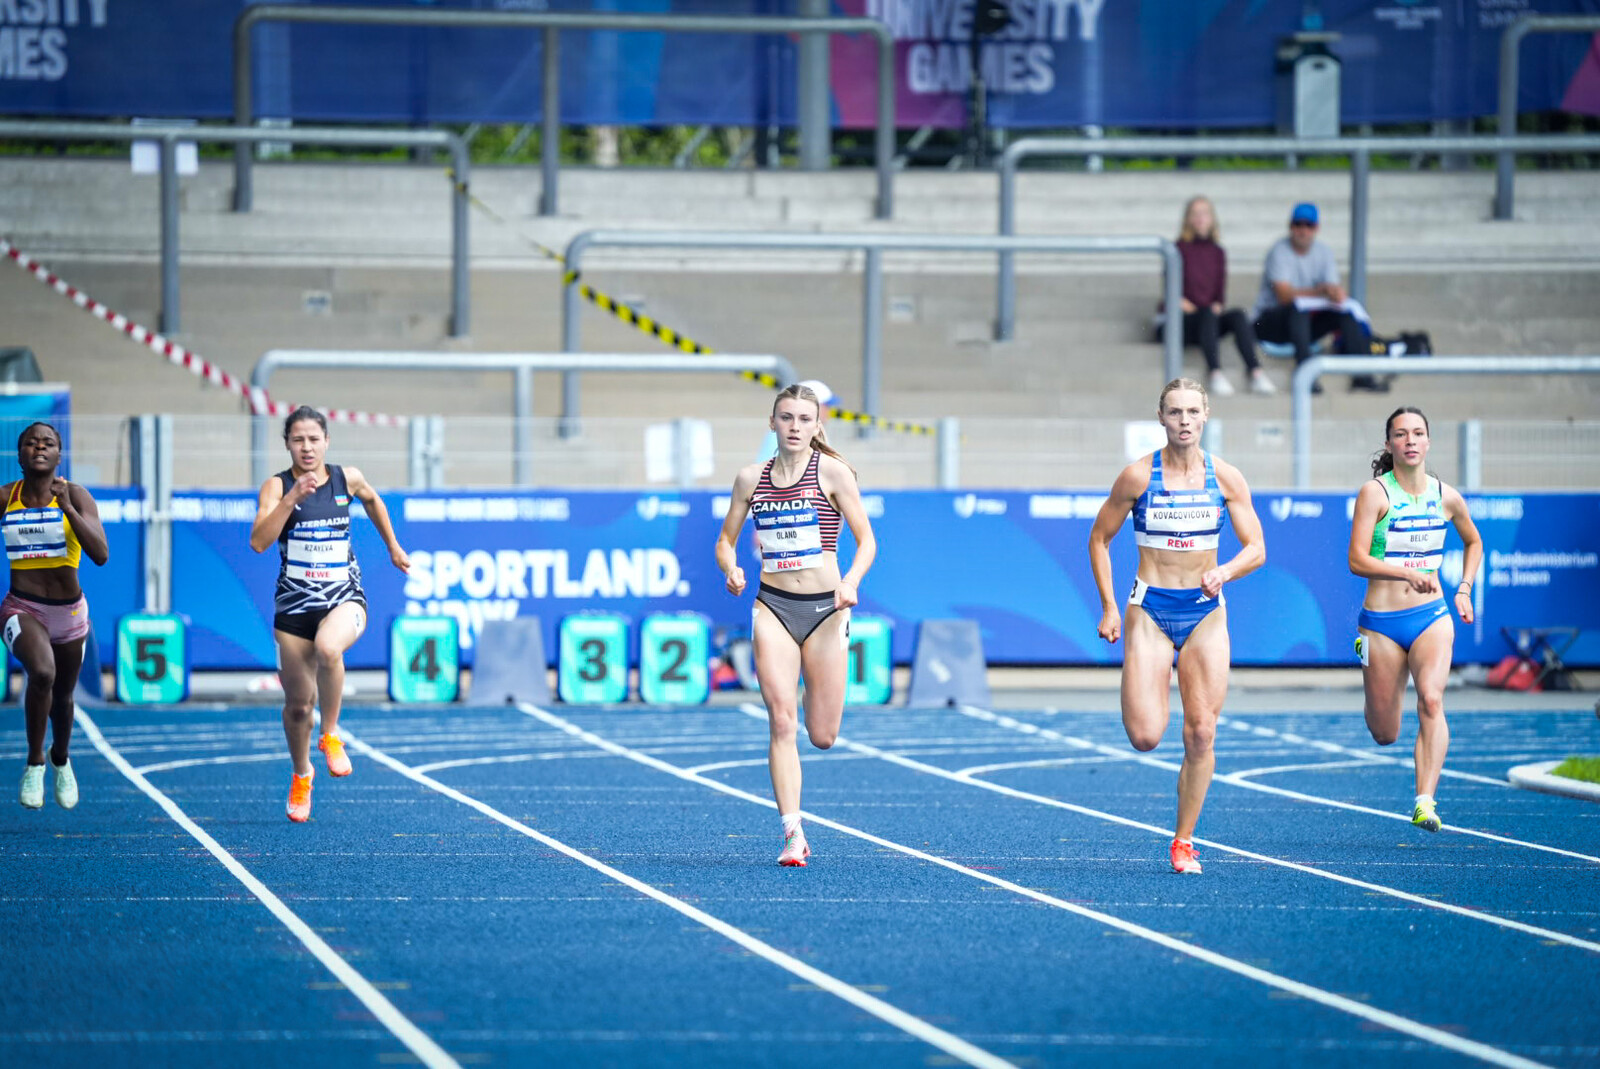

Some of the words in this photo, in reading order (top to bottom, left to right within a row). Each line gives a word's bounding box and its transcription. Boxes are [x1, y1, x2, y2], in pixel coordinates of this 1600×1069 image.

[753, 499, 813, 512] CANADA
[1153, 511, 1211, 520] KOVACOVICOVA
[776, 531, 797, 540] OLAND
[1410, 534, 1428, 542] BELIC
[1167, 539, 1195, 548] REWE
[777, 560, 802, 569] REWE
[1404, 560, 1428, 568] REWE
[305, 570, 330, 578] REWE
[403, 549, 691, 599] SPORTLAND.
[135, 638, 167, 682] 5
[409, 638, 440, 682] 4
[579, 639, 608, 682] 3
[660, 639, 689, 682] 2
[848, 641, 865, 682] 1
